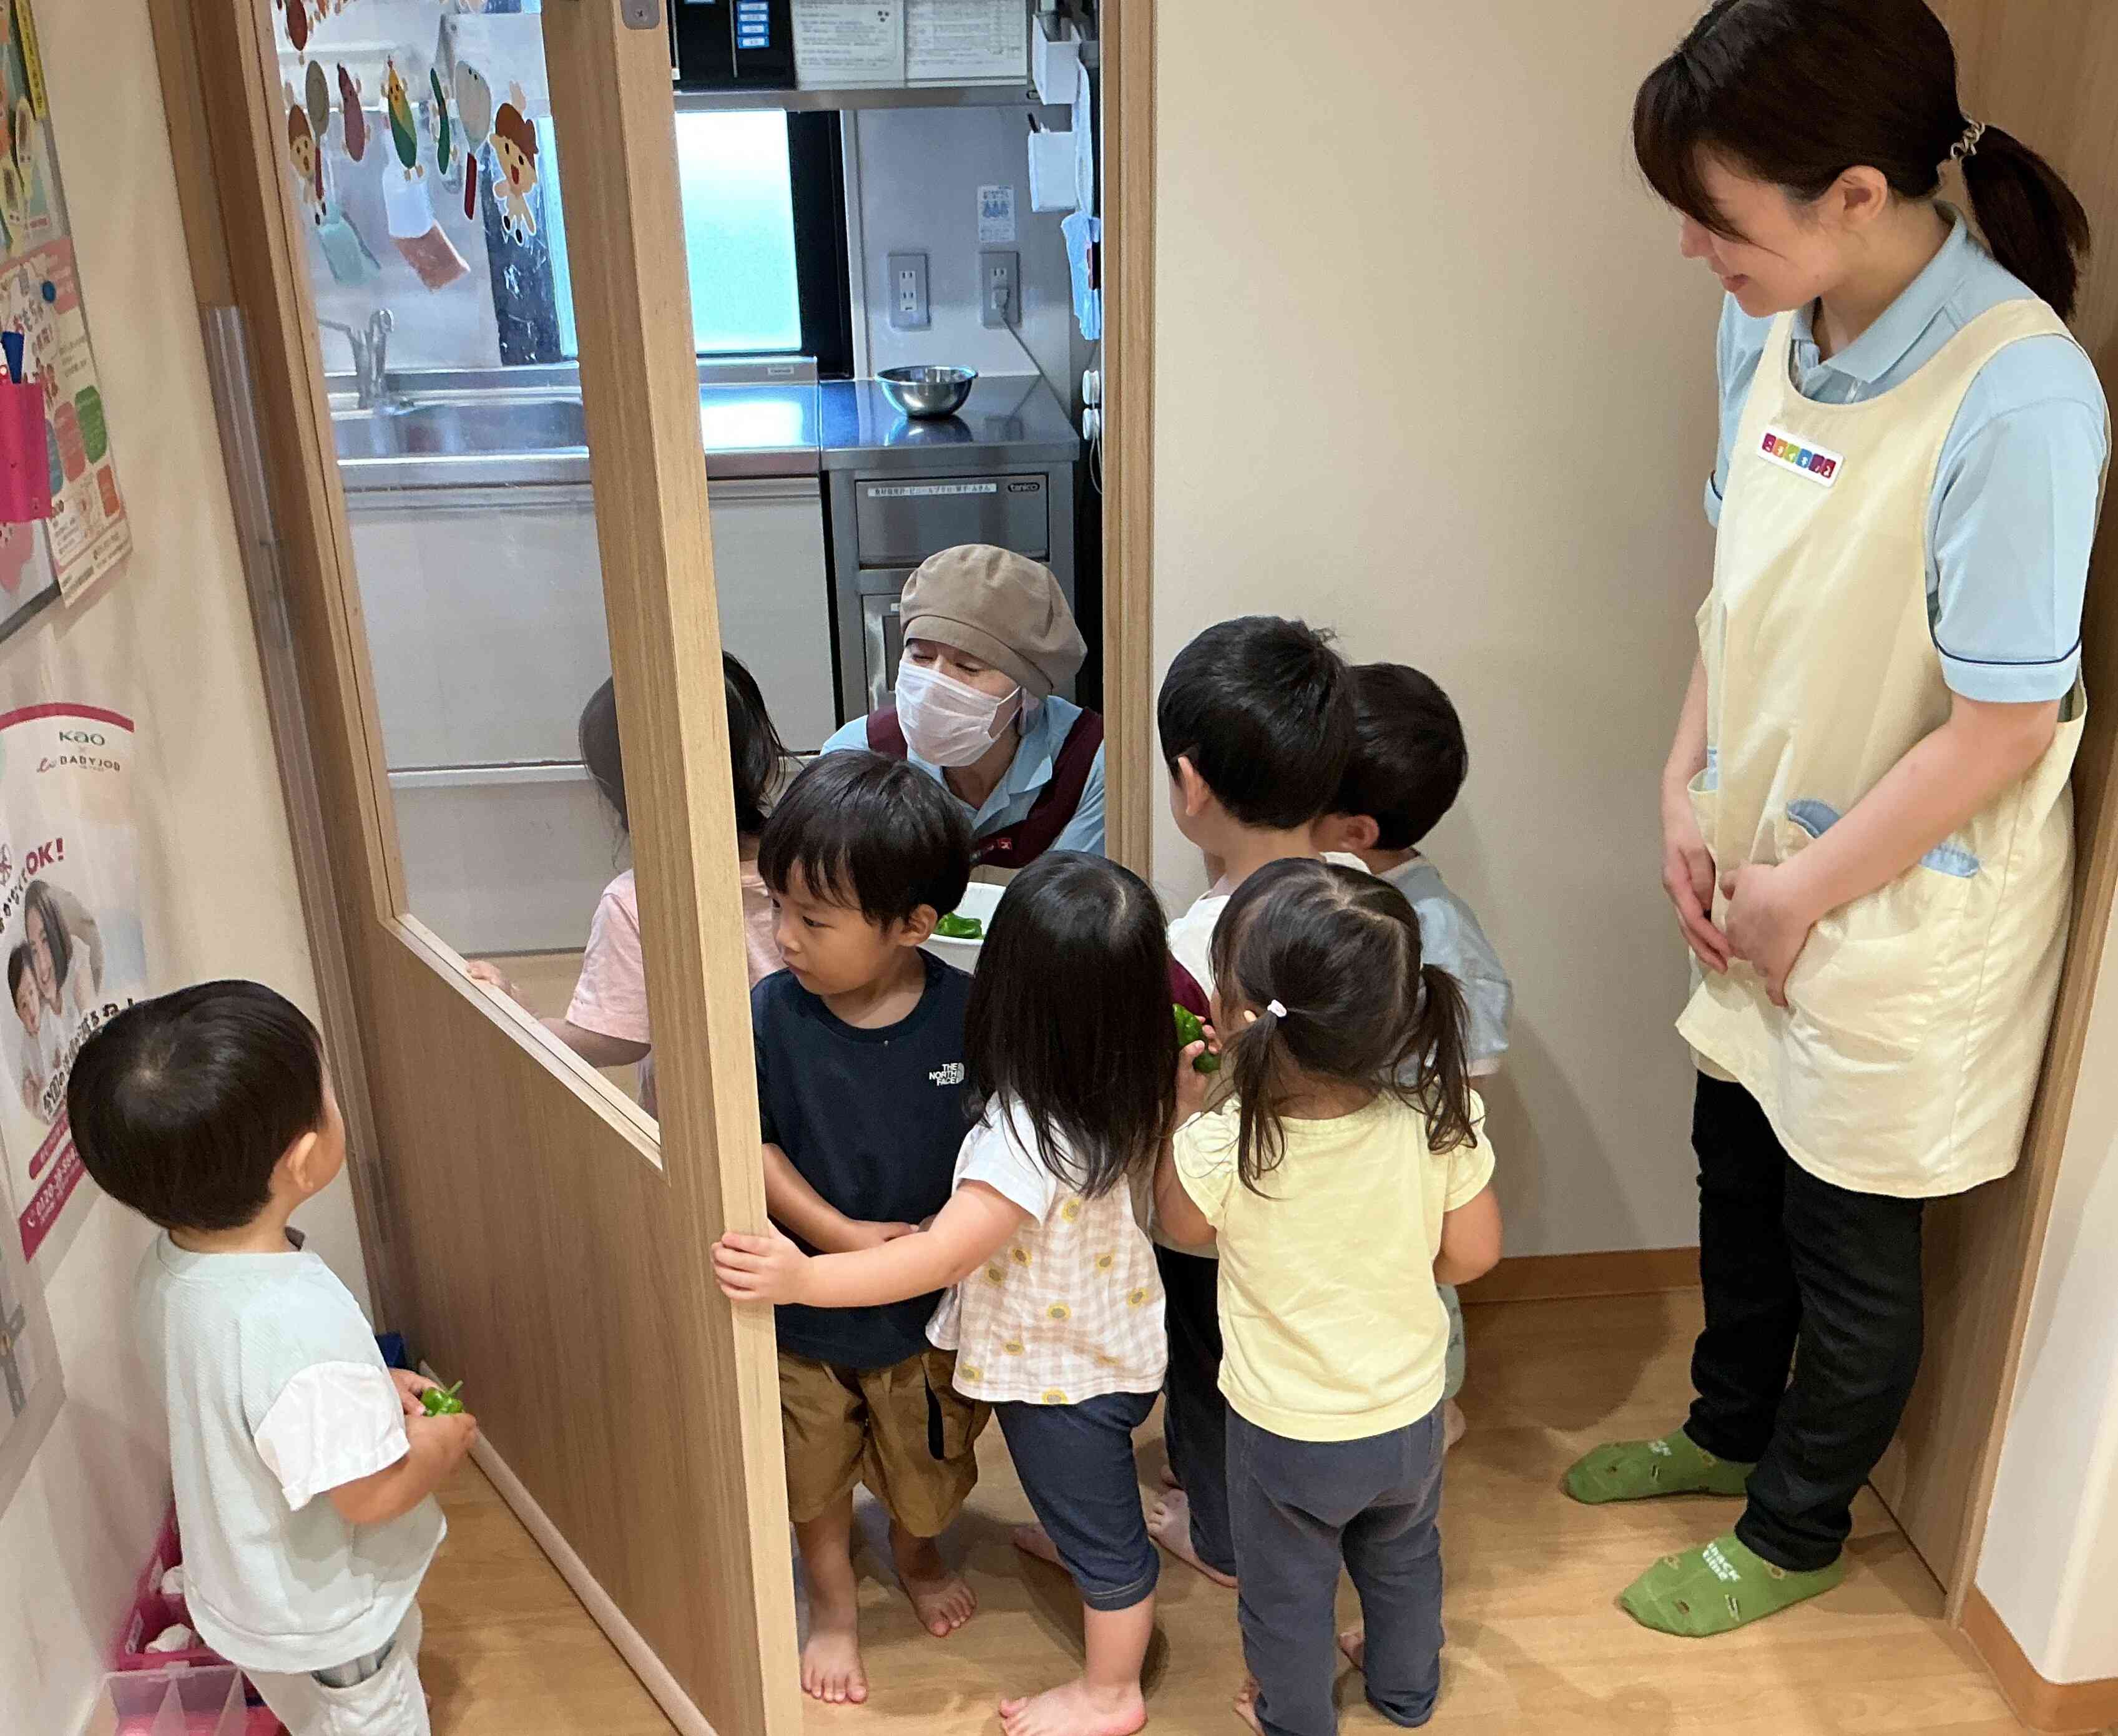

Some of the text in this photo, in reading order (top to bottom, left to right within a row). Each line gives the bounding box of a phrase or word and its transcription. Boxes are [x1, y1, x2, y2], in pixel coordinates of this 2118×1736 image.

[941, 1062, 959, 1072] THE
[929, 1070, 957, 1080] NORTH
[936, 1077, 958, 1086] FACE
